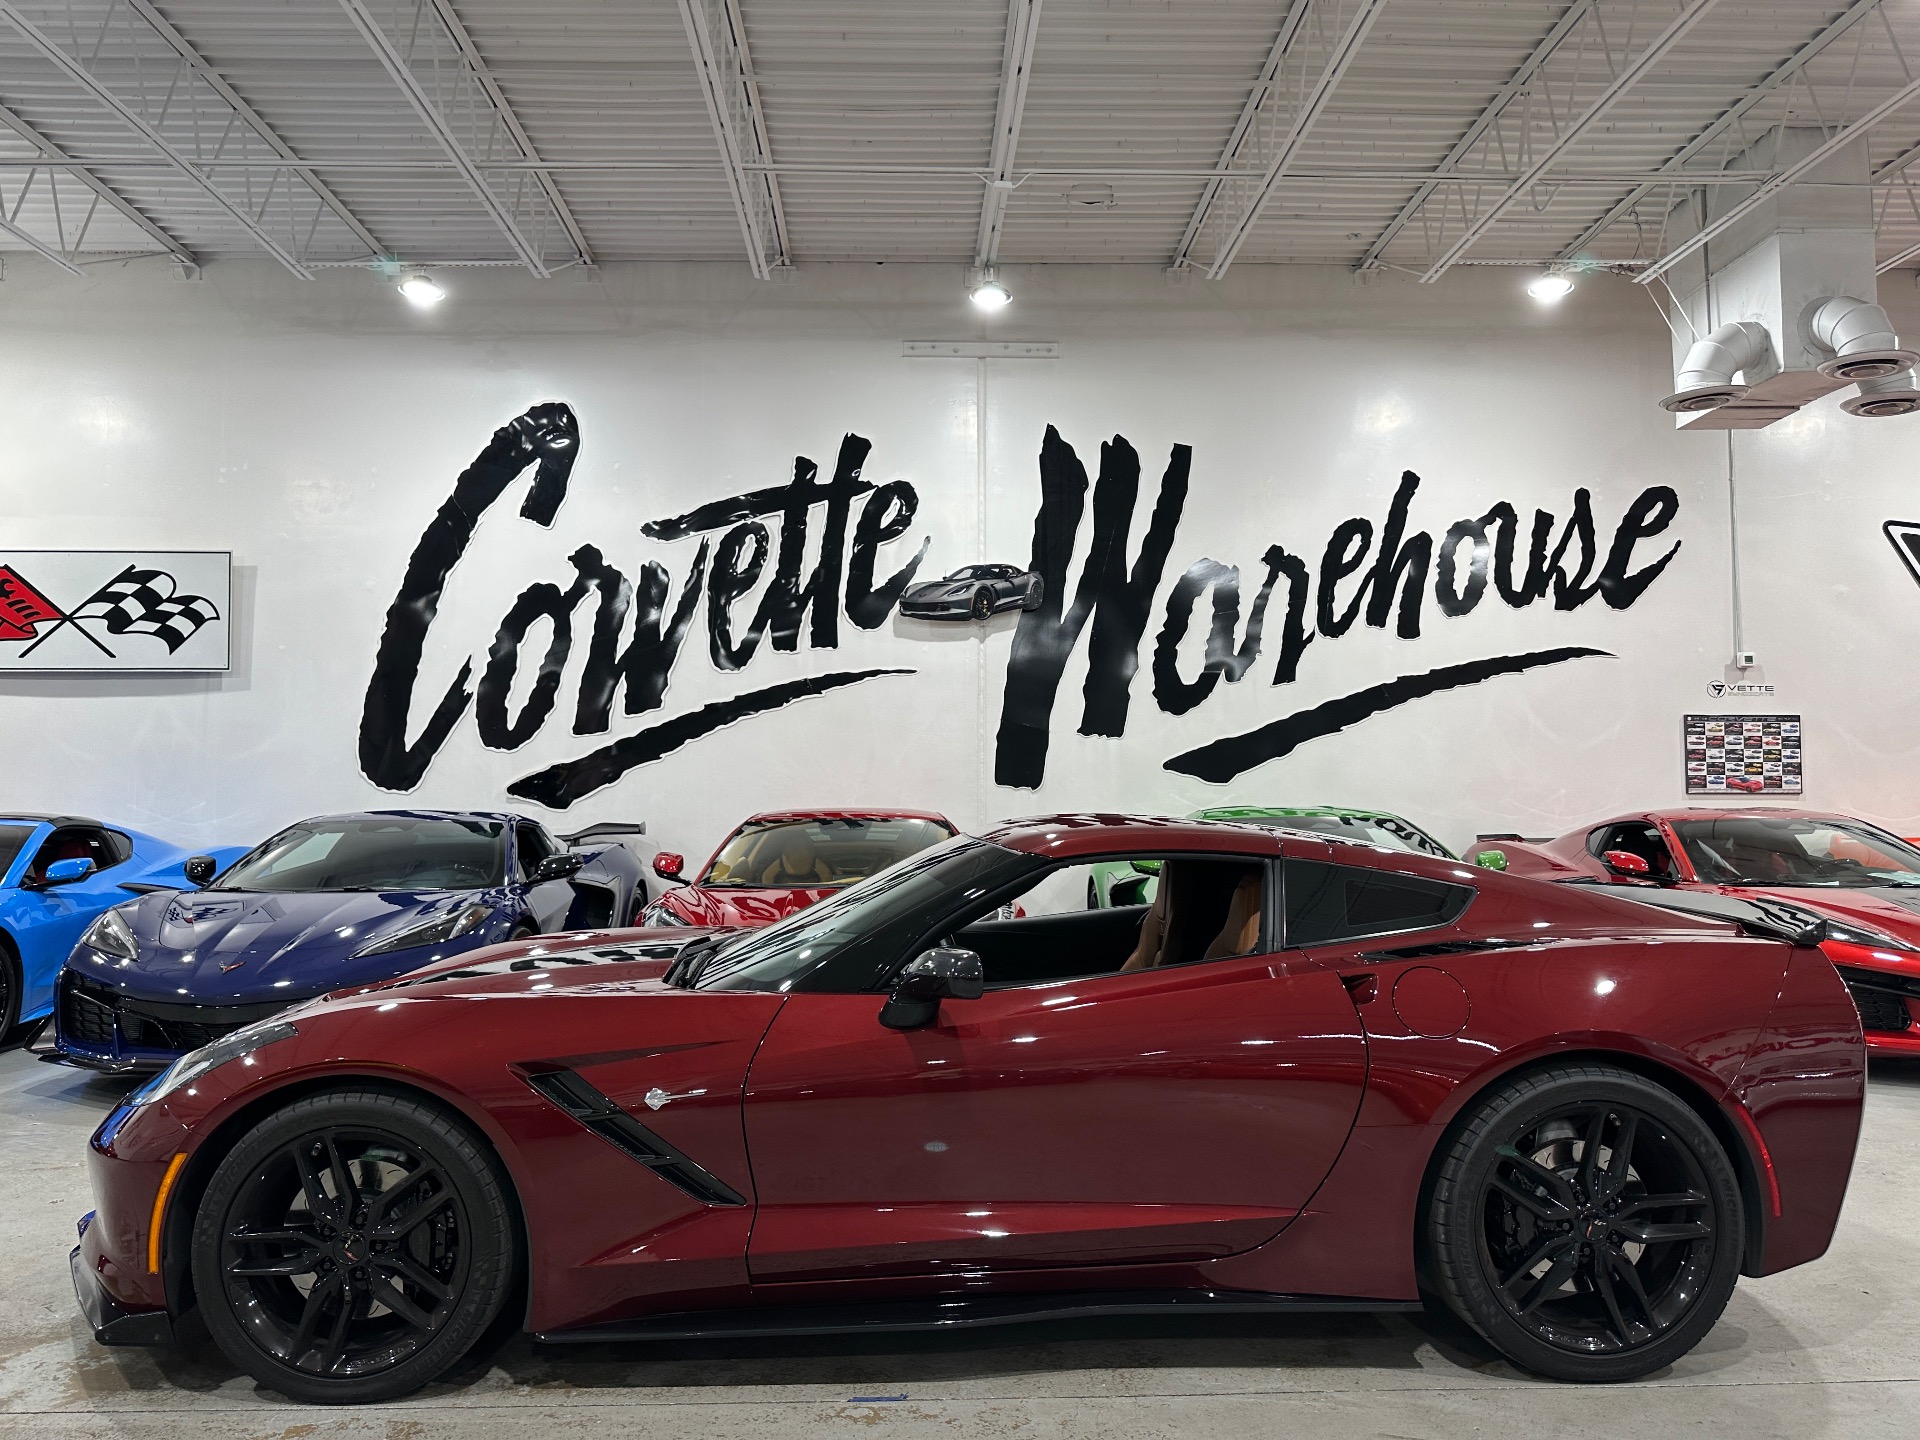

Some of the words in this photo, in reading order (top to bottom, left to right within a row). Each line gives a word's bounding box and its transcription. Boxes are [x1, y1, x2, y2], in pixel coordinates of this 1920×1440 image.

[359, 402, 930, 792] Corvette
[995, 424, 1681, 789] Warehouse
[1727, 684, 1775, 692] VETTE
